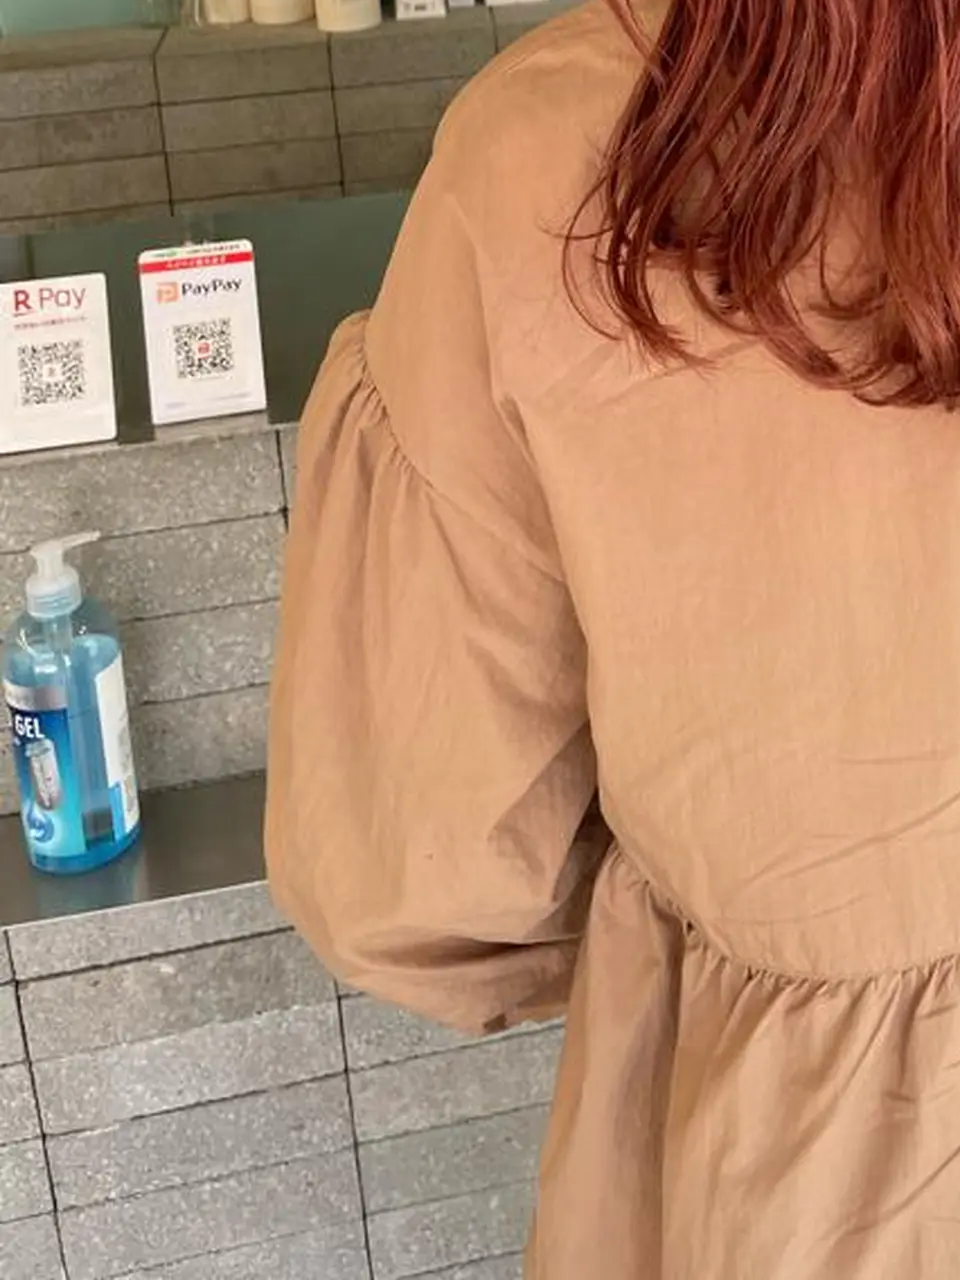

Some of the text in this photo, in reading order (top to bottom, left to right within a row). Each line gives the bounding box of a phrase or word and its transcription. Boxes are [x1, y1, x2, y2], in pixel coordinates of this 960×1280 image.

[182, 278, 242, 296] PayPay
[14, 287, 86, 312] R Pay
[15, 714, 45, 738] GEL
